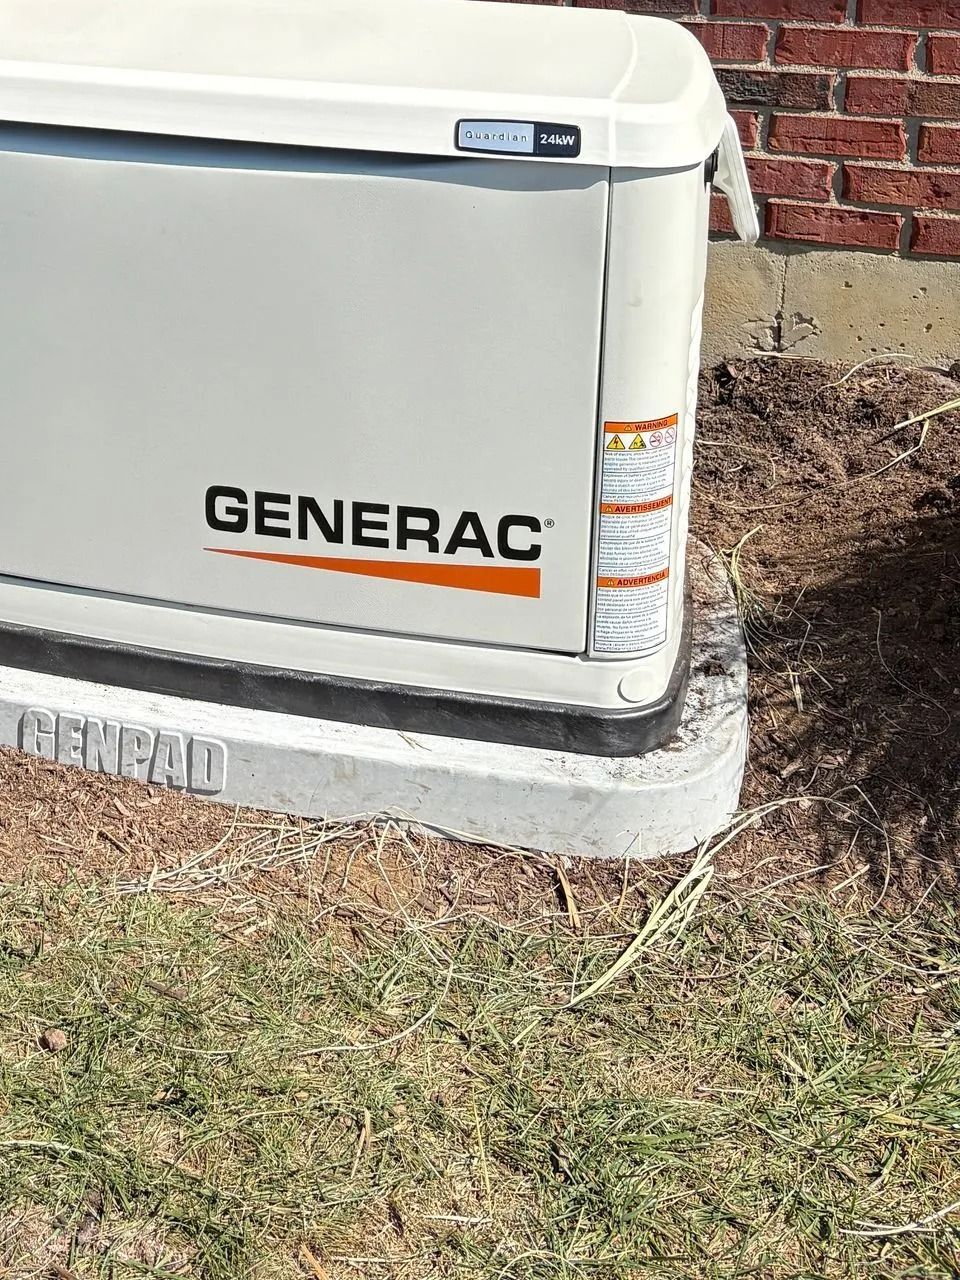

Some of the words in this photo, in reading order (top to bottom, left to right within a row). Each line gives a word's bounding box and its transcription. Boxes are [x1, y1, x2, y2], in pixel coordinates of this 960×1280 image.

[465, 130, 527, 142] Guardian
[540, 134, 575, 146] 24kW
[634, 419, 668, 431] WARNING
[615, 496, 671, 513] AVERTISSEMENT
[617, 572, 665, 586] ADVERTENCIA
[17, 707, 227, 795] GENPAD
